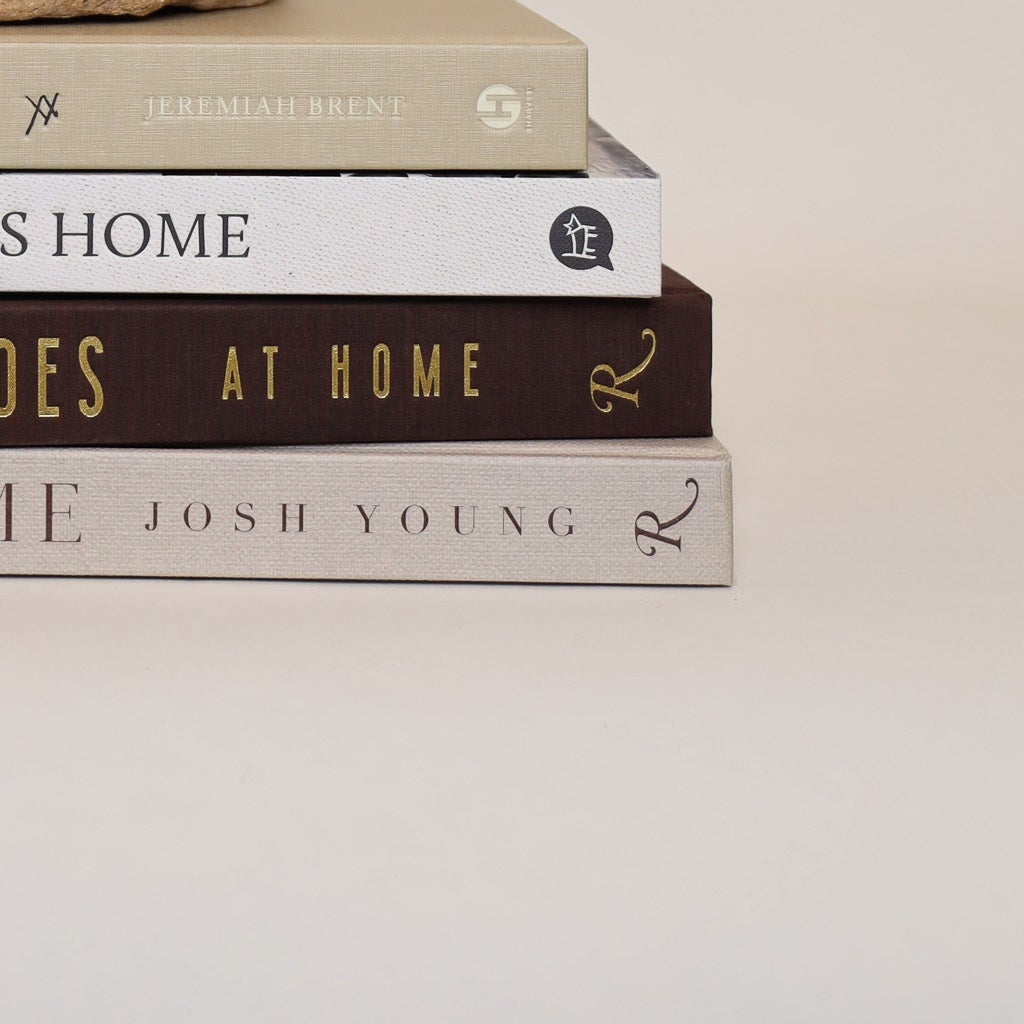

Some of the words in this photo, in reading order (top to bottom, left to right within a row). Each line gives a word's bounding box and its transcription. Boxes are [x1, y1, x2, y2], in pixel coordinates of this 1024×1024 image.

[144, 95, 297, 120] JEREMIAH
[307, 95, 406, 116] BRENT
[51, 212, 251, 258] HOME
[221, 345, 280, 401] AT
[331, 342, 481, 399] HOME
[144, 501, 308, 534] JOSH
[354, 504, 576, 537] YOUNG
